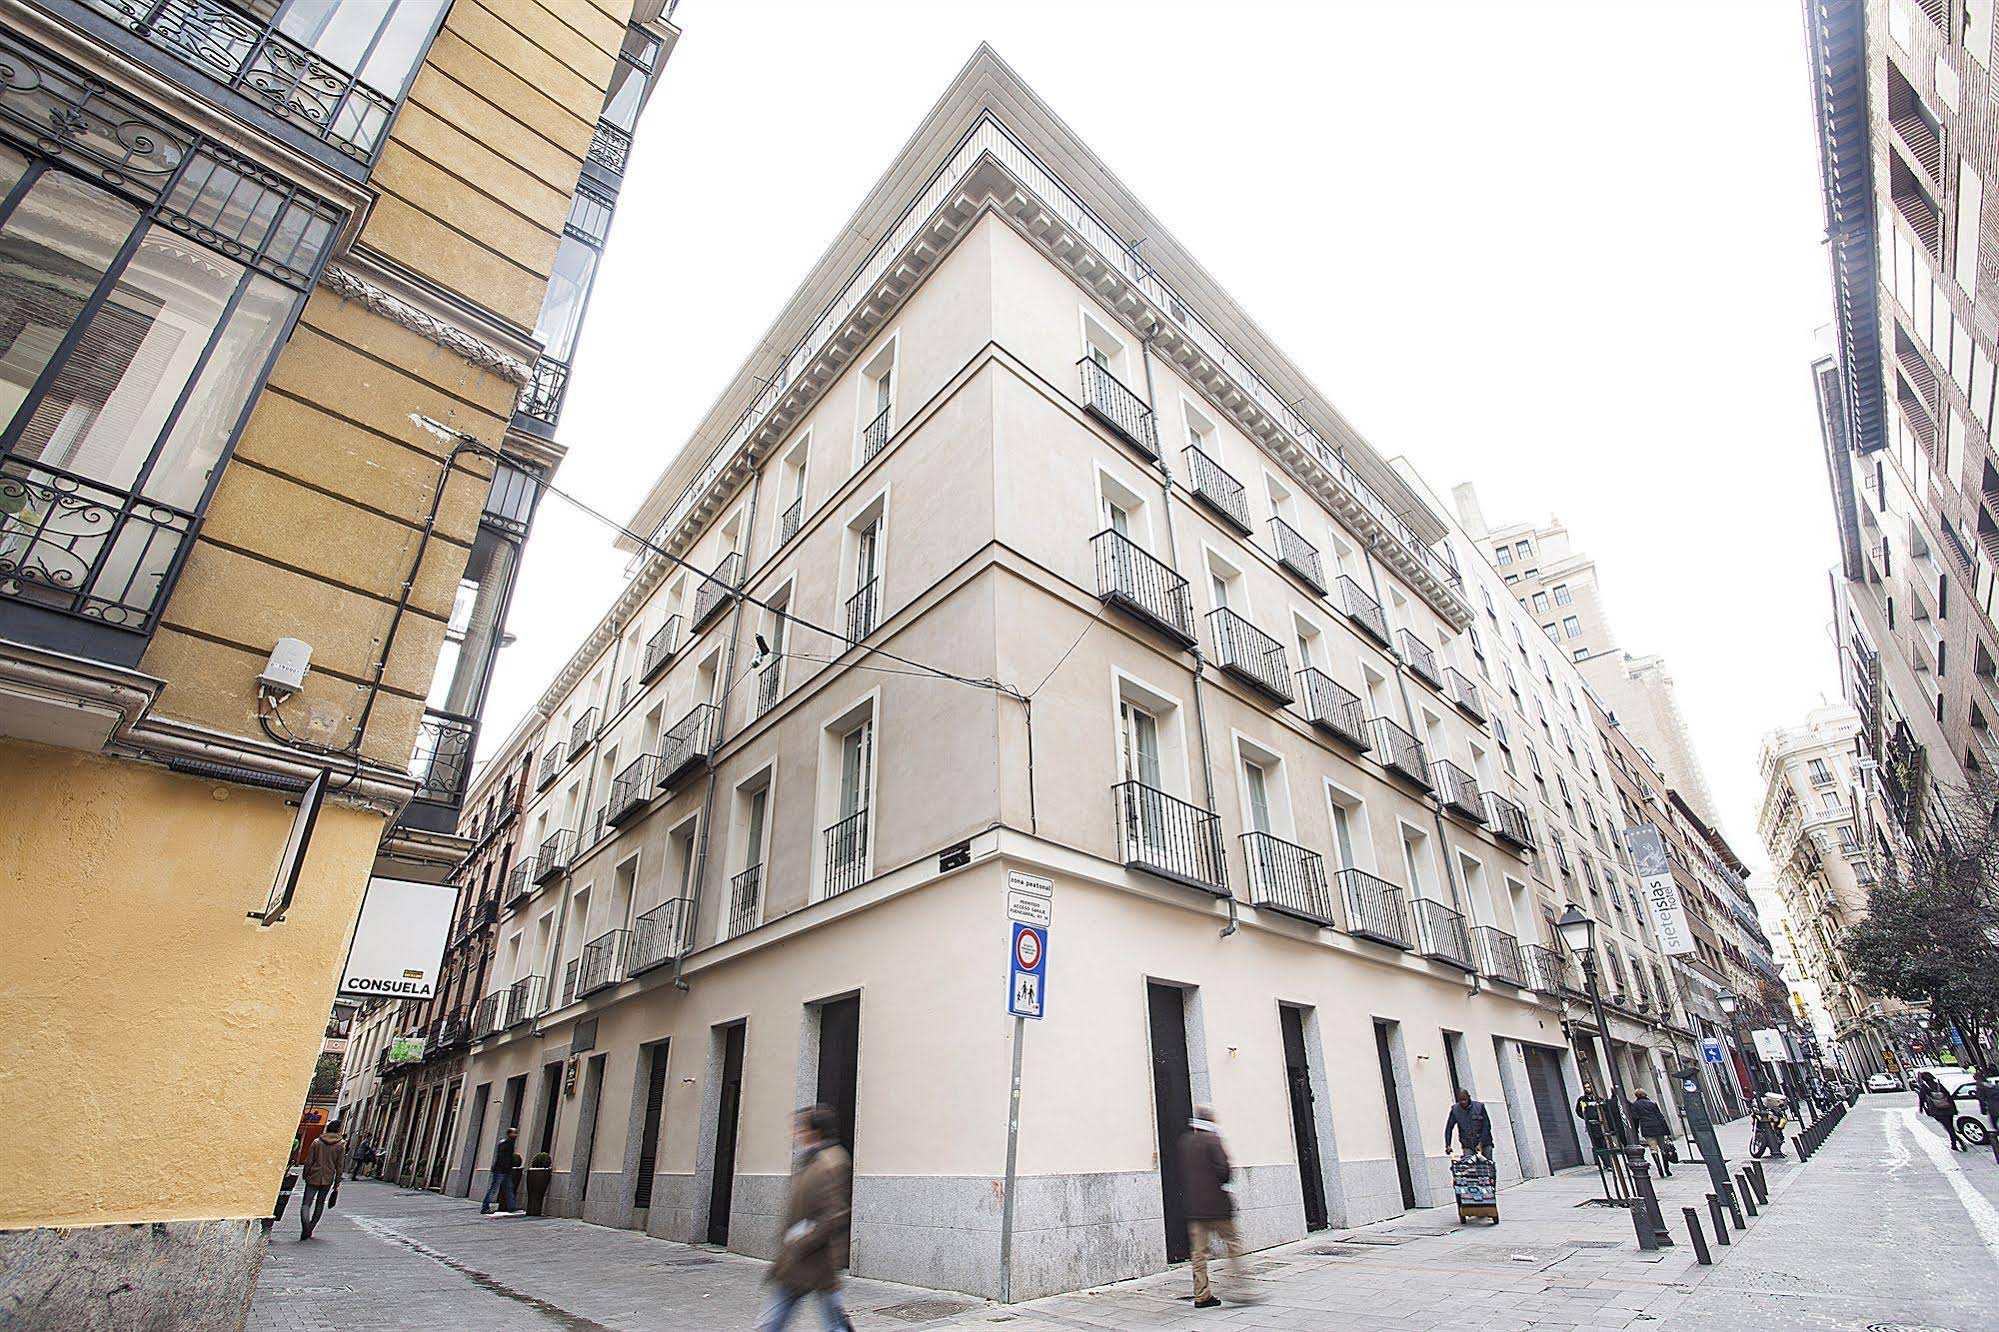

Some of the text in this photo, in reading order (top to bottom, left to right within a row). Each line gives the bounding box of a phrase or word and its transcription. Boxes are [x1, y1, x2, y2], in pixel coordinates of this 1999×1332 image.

[1026, 881, 1051, 891] peatonal
[1664, 886, 1678, 910] hotel
[348, 978, 430, 995] CONSUELA
